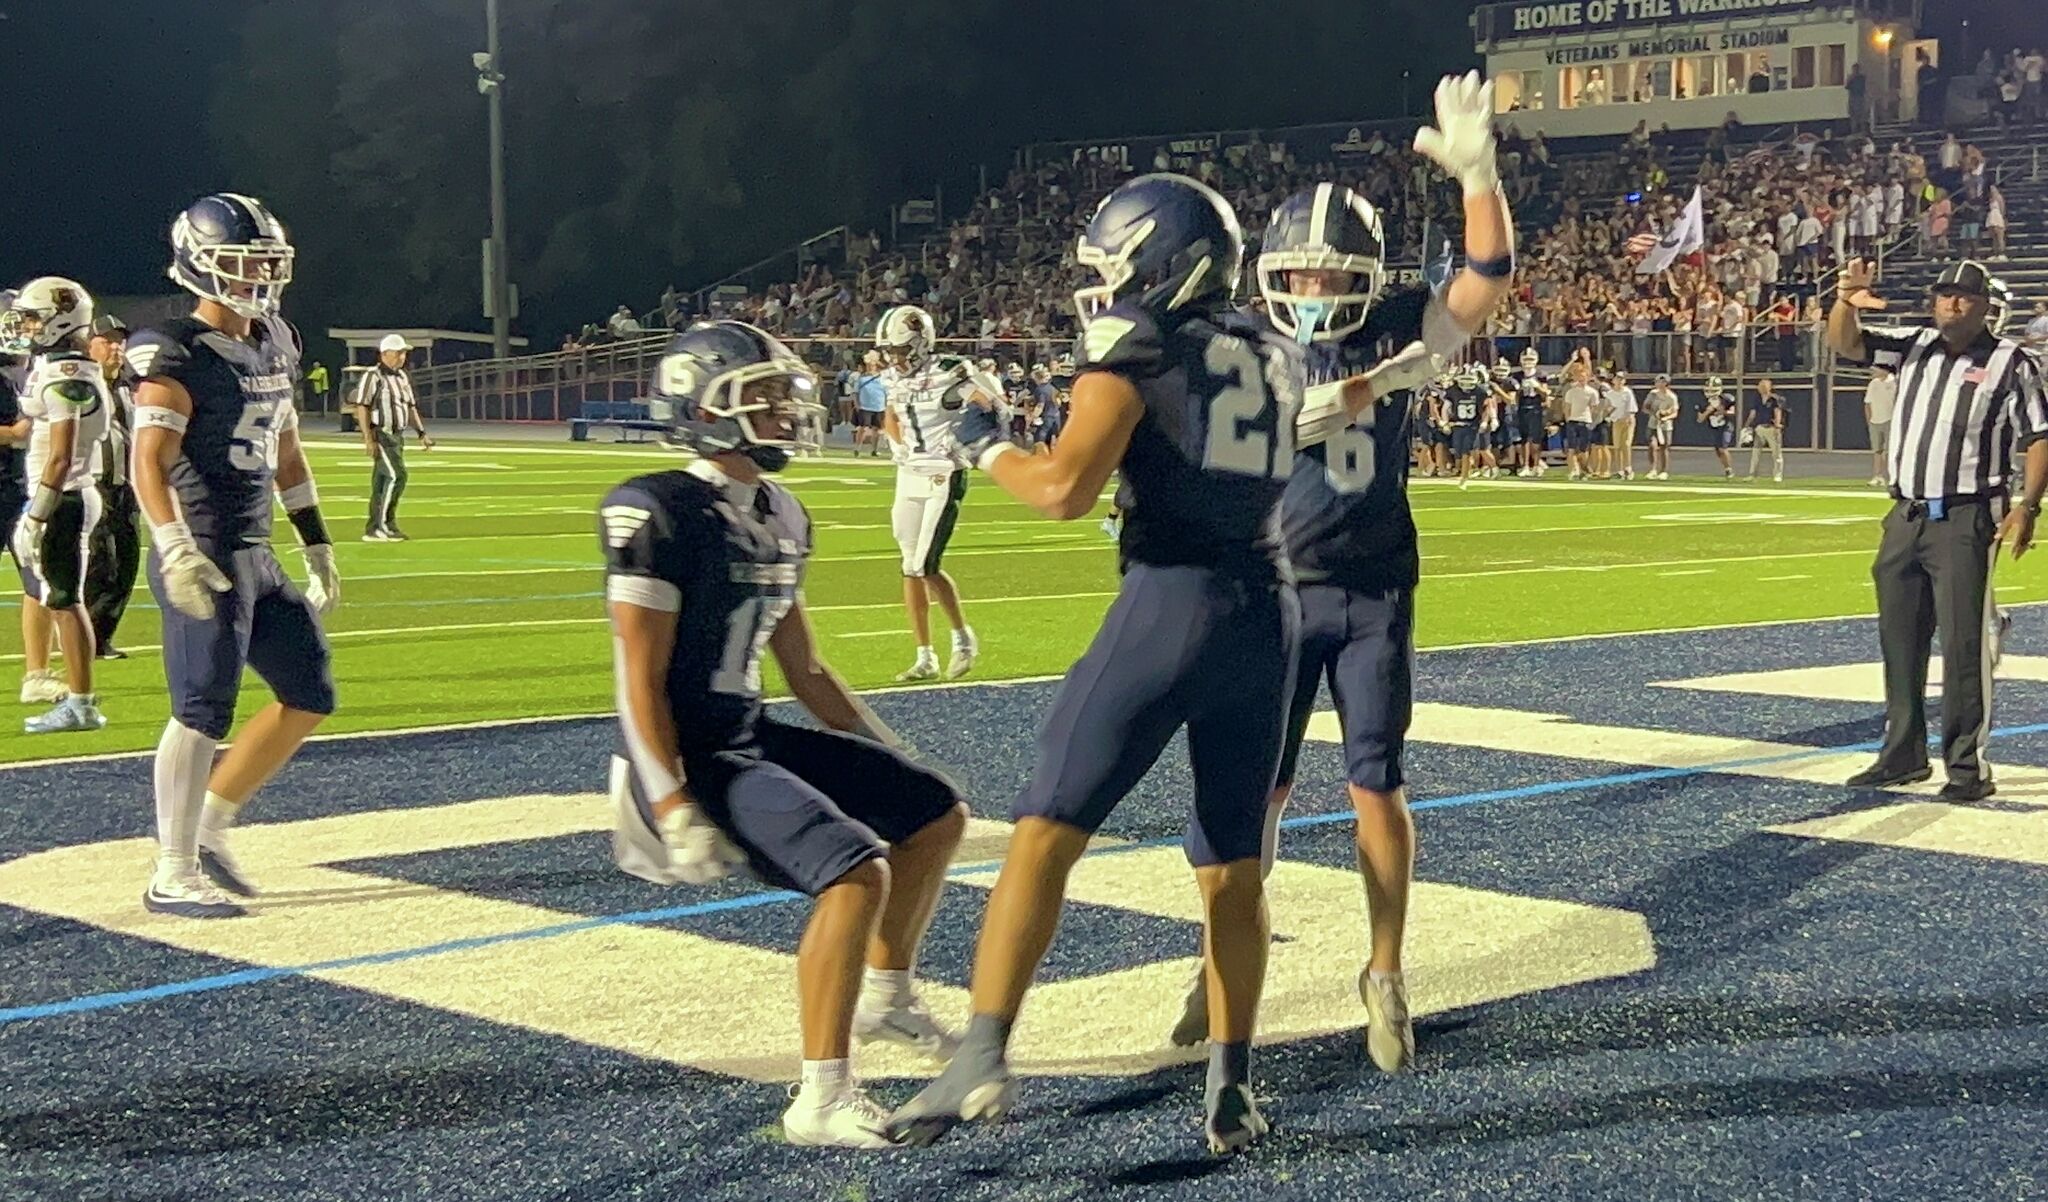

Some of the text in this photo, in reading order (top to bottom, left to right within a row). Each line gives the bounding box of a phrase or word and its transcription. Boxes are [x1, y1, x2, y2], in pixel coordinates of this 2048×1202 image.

[1514, 3, 1582, 30] HOME
[1587, 0, 1618, 24] OF
[1624, 0, 1672, 20] THE
[1546, 28, 1789, 65] VETERANS MEMORIAL STADIUM
